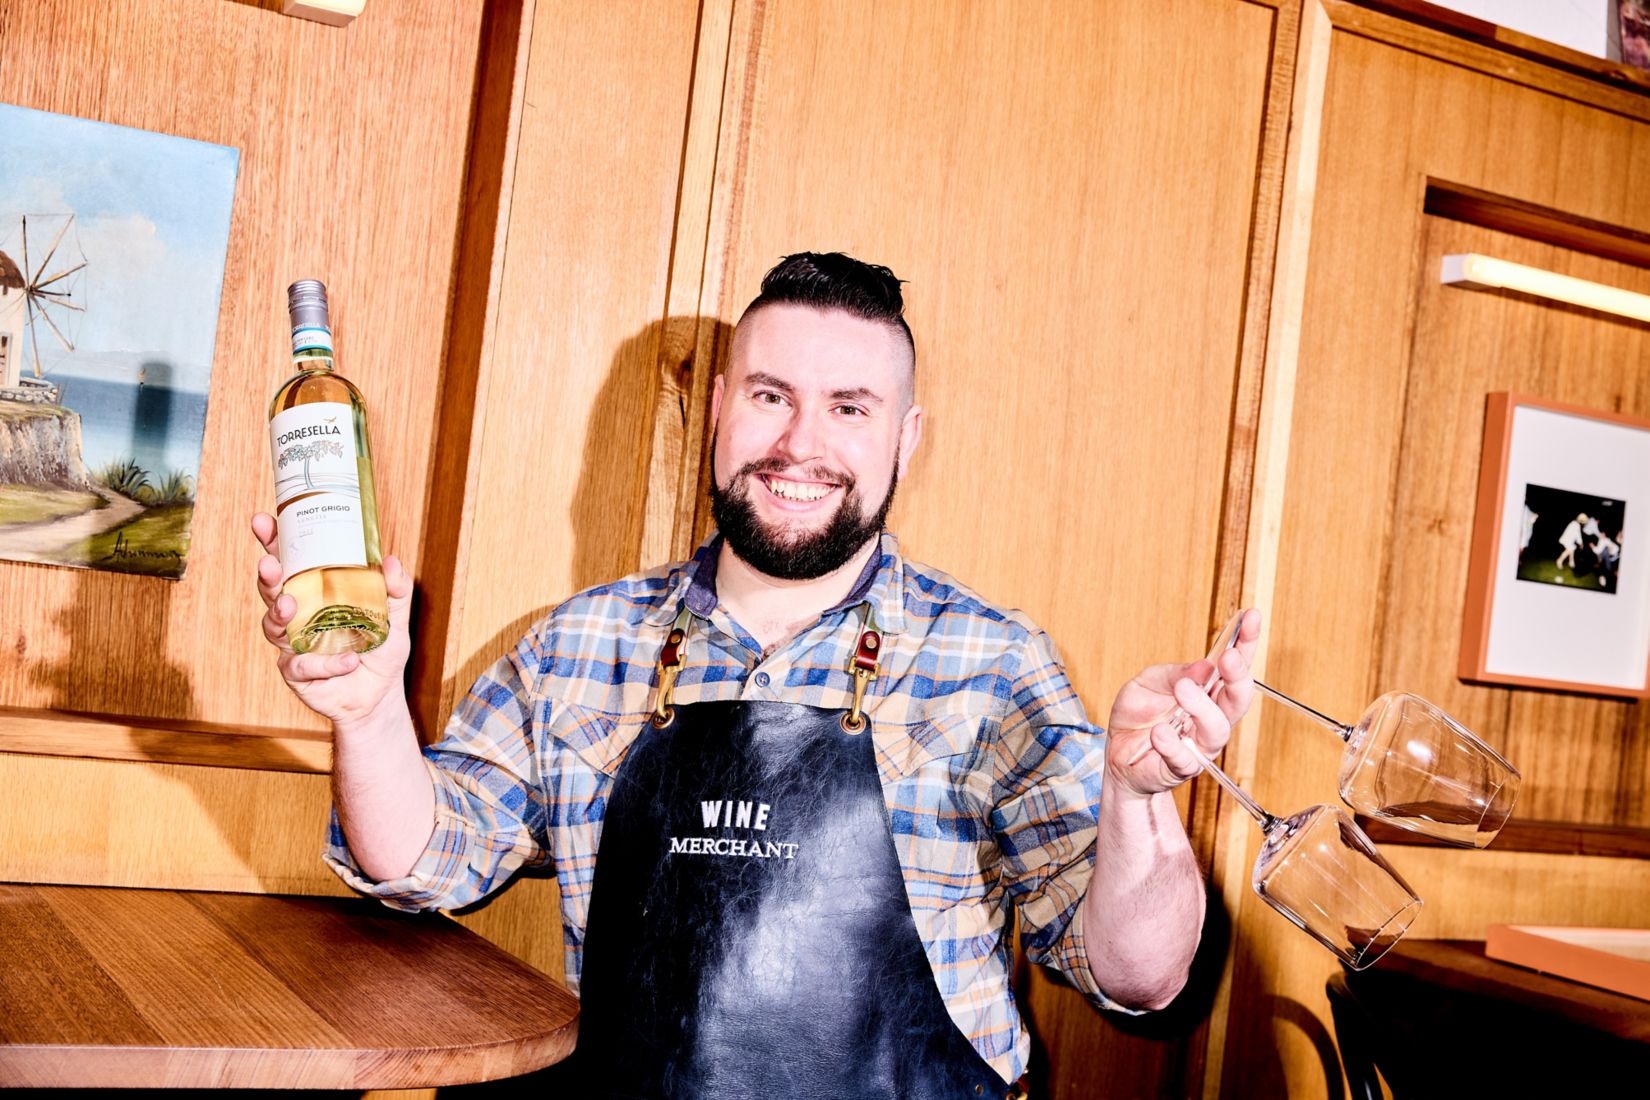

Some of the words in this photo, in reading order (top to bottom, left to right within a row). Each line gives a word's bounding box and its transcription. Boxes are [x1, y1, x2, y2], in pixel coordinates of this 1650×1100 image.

[277, 425, 341, 447] TORRESELLA
[296, 507, 319, 517] PINOT
[701, 800, 771, 831] WINE
[669, 836, 799, 859] MERCHANT
